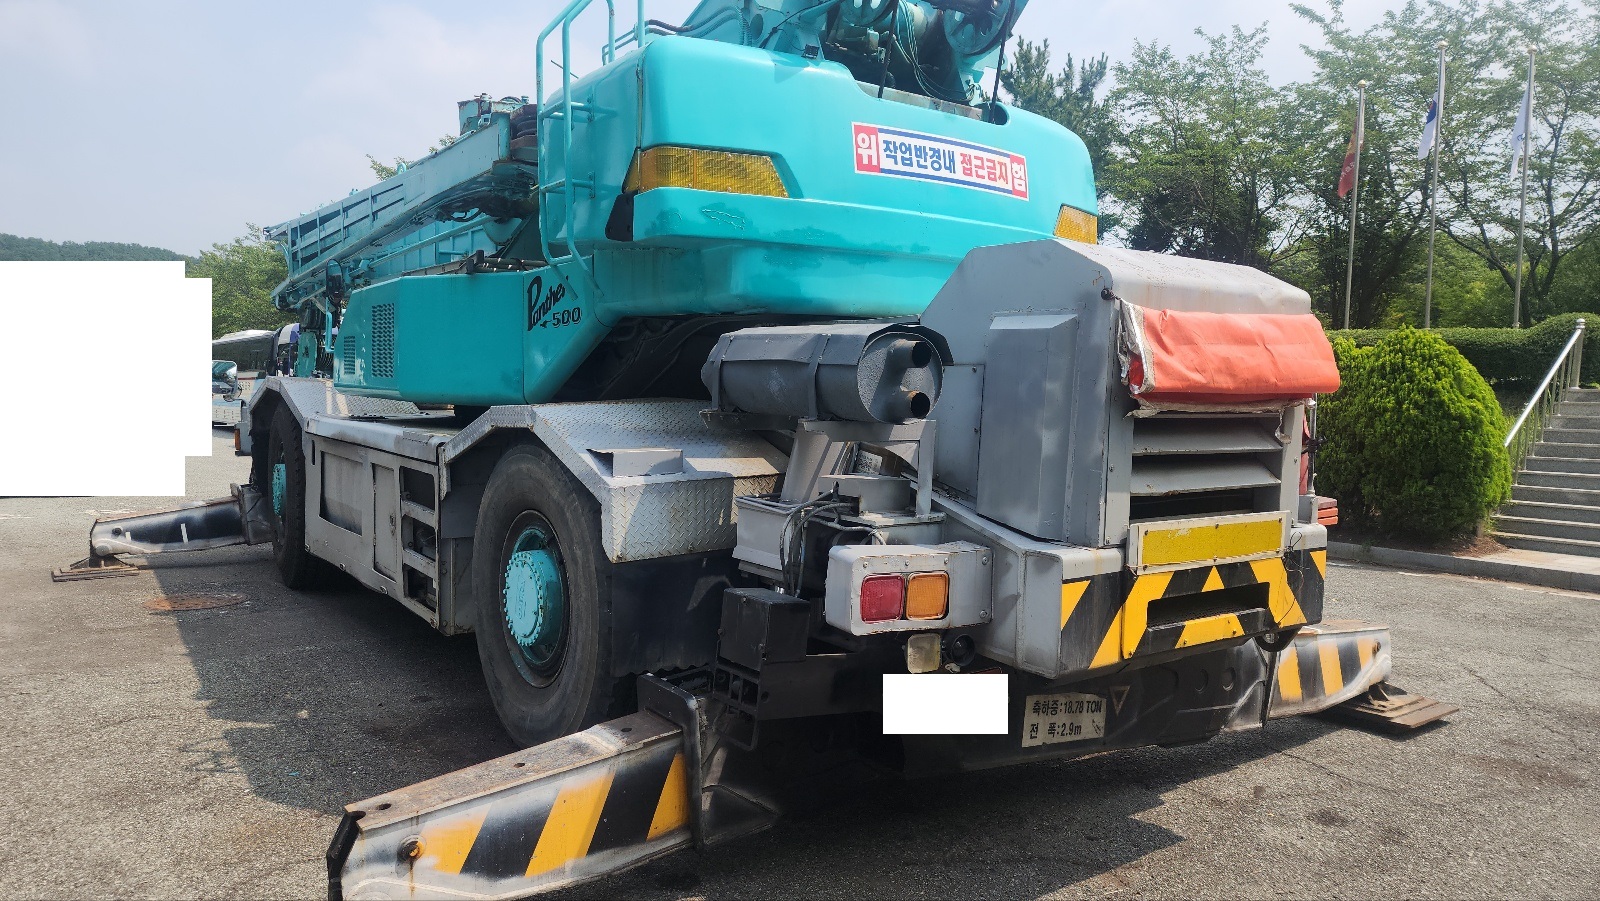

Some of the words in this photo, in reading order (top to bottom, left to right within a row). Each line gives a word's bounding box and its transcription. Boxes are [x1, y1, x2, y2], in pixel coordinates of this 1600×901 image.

[857, 133, 878, 166] 위
[882, 139, 956, 174] 작업반경내
[960, 152, 1009, 185] 접근금지
[1011, 161, 1026, 192] 험
[527, 275, 568, 331] Panthe
[552, 306, 582, 328] 500
[1086, 700, 1103, 713] TON
[1029, 722, 1039, 739] 전
[1047, 722, 1082, 737] 폭:2.9m
